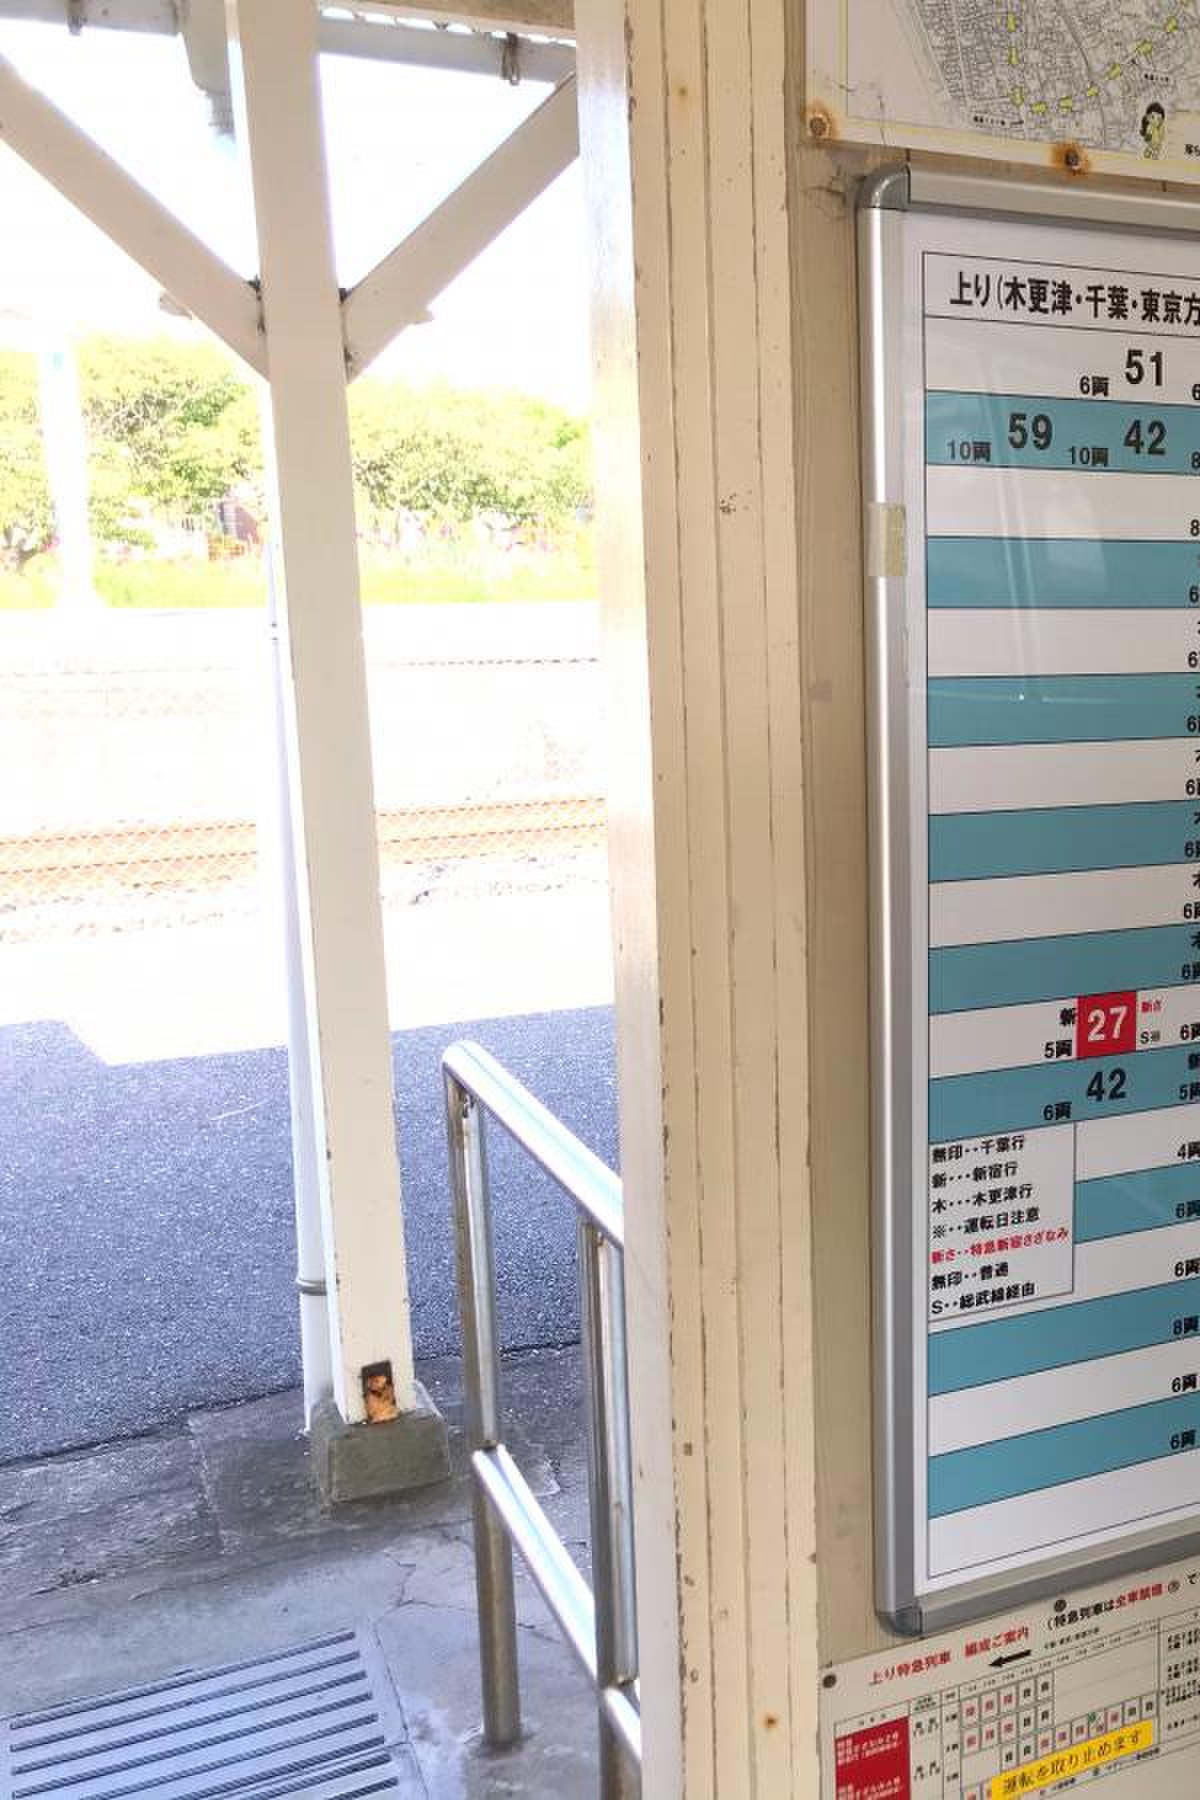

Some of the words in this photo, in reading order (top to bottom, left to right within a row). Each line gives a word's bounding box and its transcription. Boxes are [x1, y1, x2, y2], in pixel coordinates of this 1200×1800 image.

[1080, 376, 1109, 396] 6両
[1126, 350, 1162, 386] 51
[947, 439, 991, 463] 10両
[1008, 413, 1052, 450] 59
[1068, 445, 1109, 469] 10両
[1124, 420, 1166, 455] 42
[1045, 1040, 1072, 1058] 5両
[1086, 1005, 1124, 1042] 27
[1044, 1102, 1072, 1120] 6両
[1087, 1068, 1126, 1101] 42
[1175, 1258, 1200, 1277] 6両
[1171, 1374, 1197, 1393] 6両
